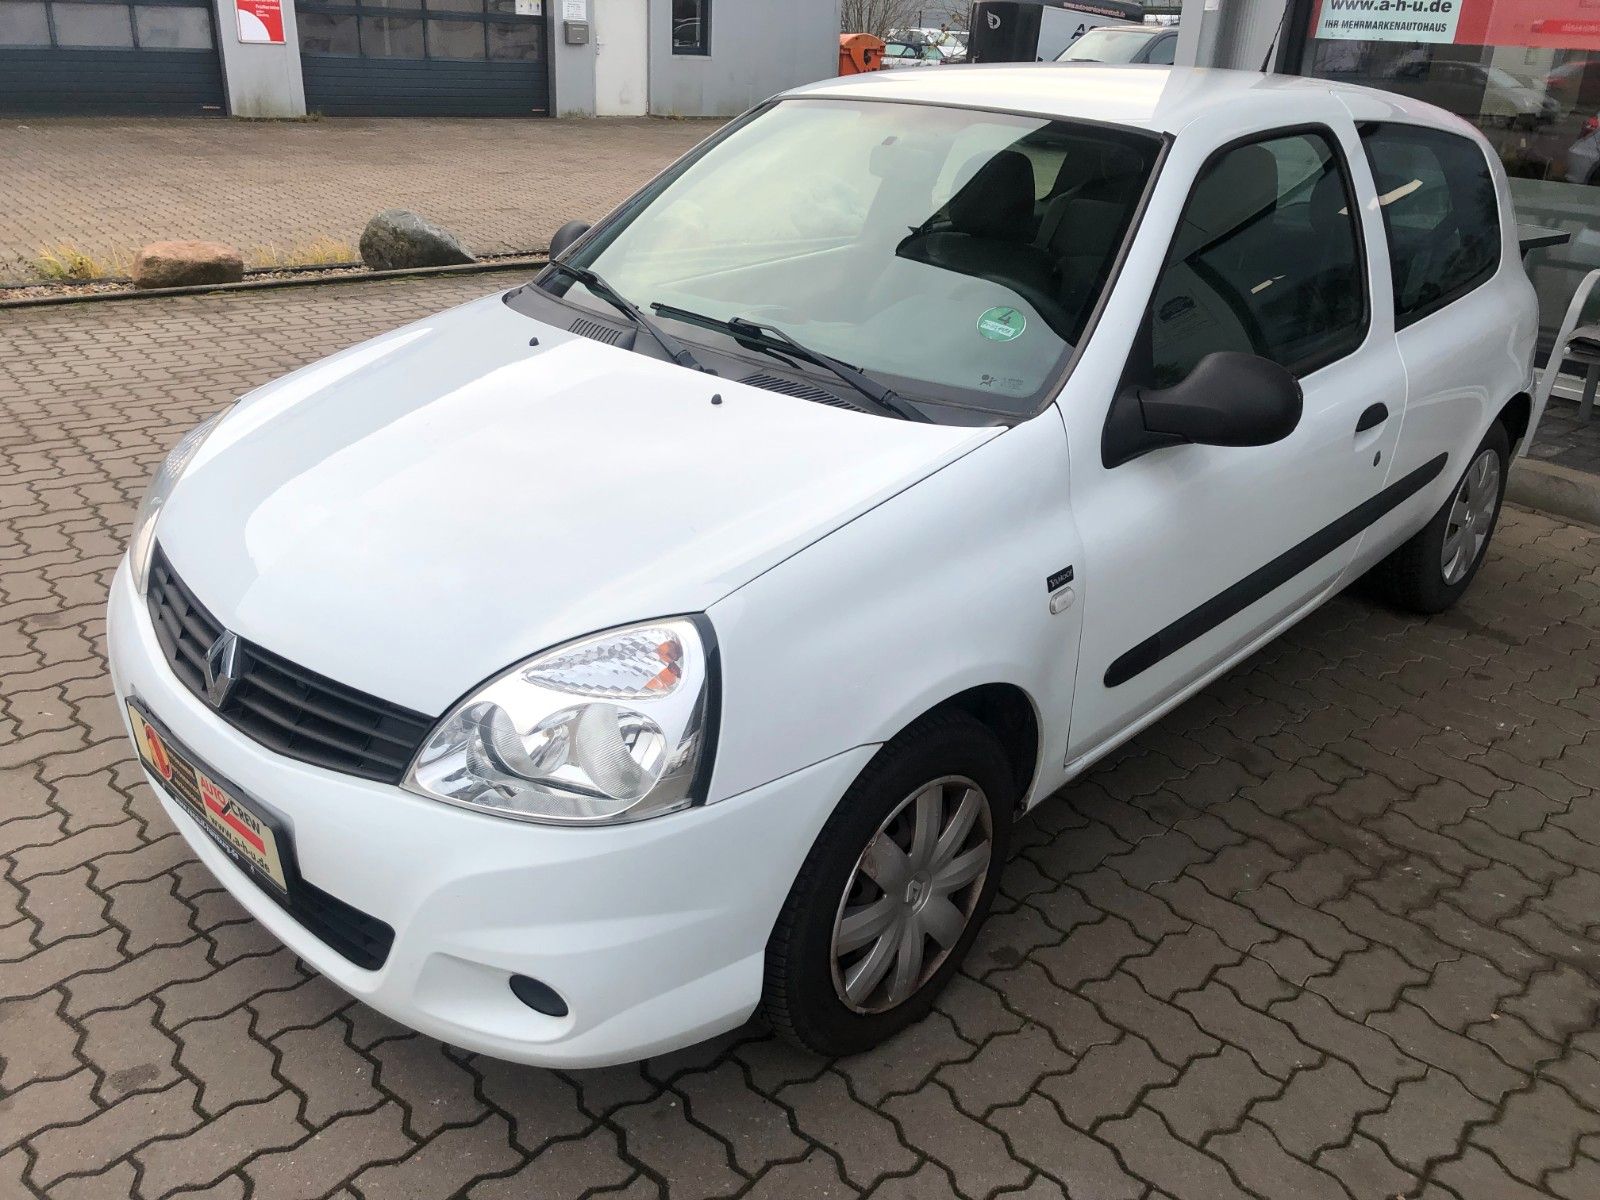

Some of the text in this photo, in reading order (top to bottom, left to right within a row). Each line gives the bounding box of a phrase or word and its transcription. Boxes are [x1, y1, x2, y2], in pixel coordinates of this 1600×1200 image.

[1330, 0, 1453, 13] www.a-h-u.de
[1325, 19, 1448, 33] IHR MEHRMARKENAUTOHAUS
[998, 310, 1015, 325] 4
[200, 775, 228, 805] AUTO
[230, 801, 262, 836] CREW
[210, 814, 271, 874] www.a-h-u.de
